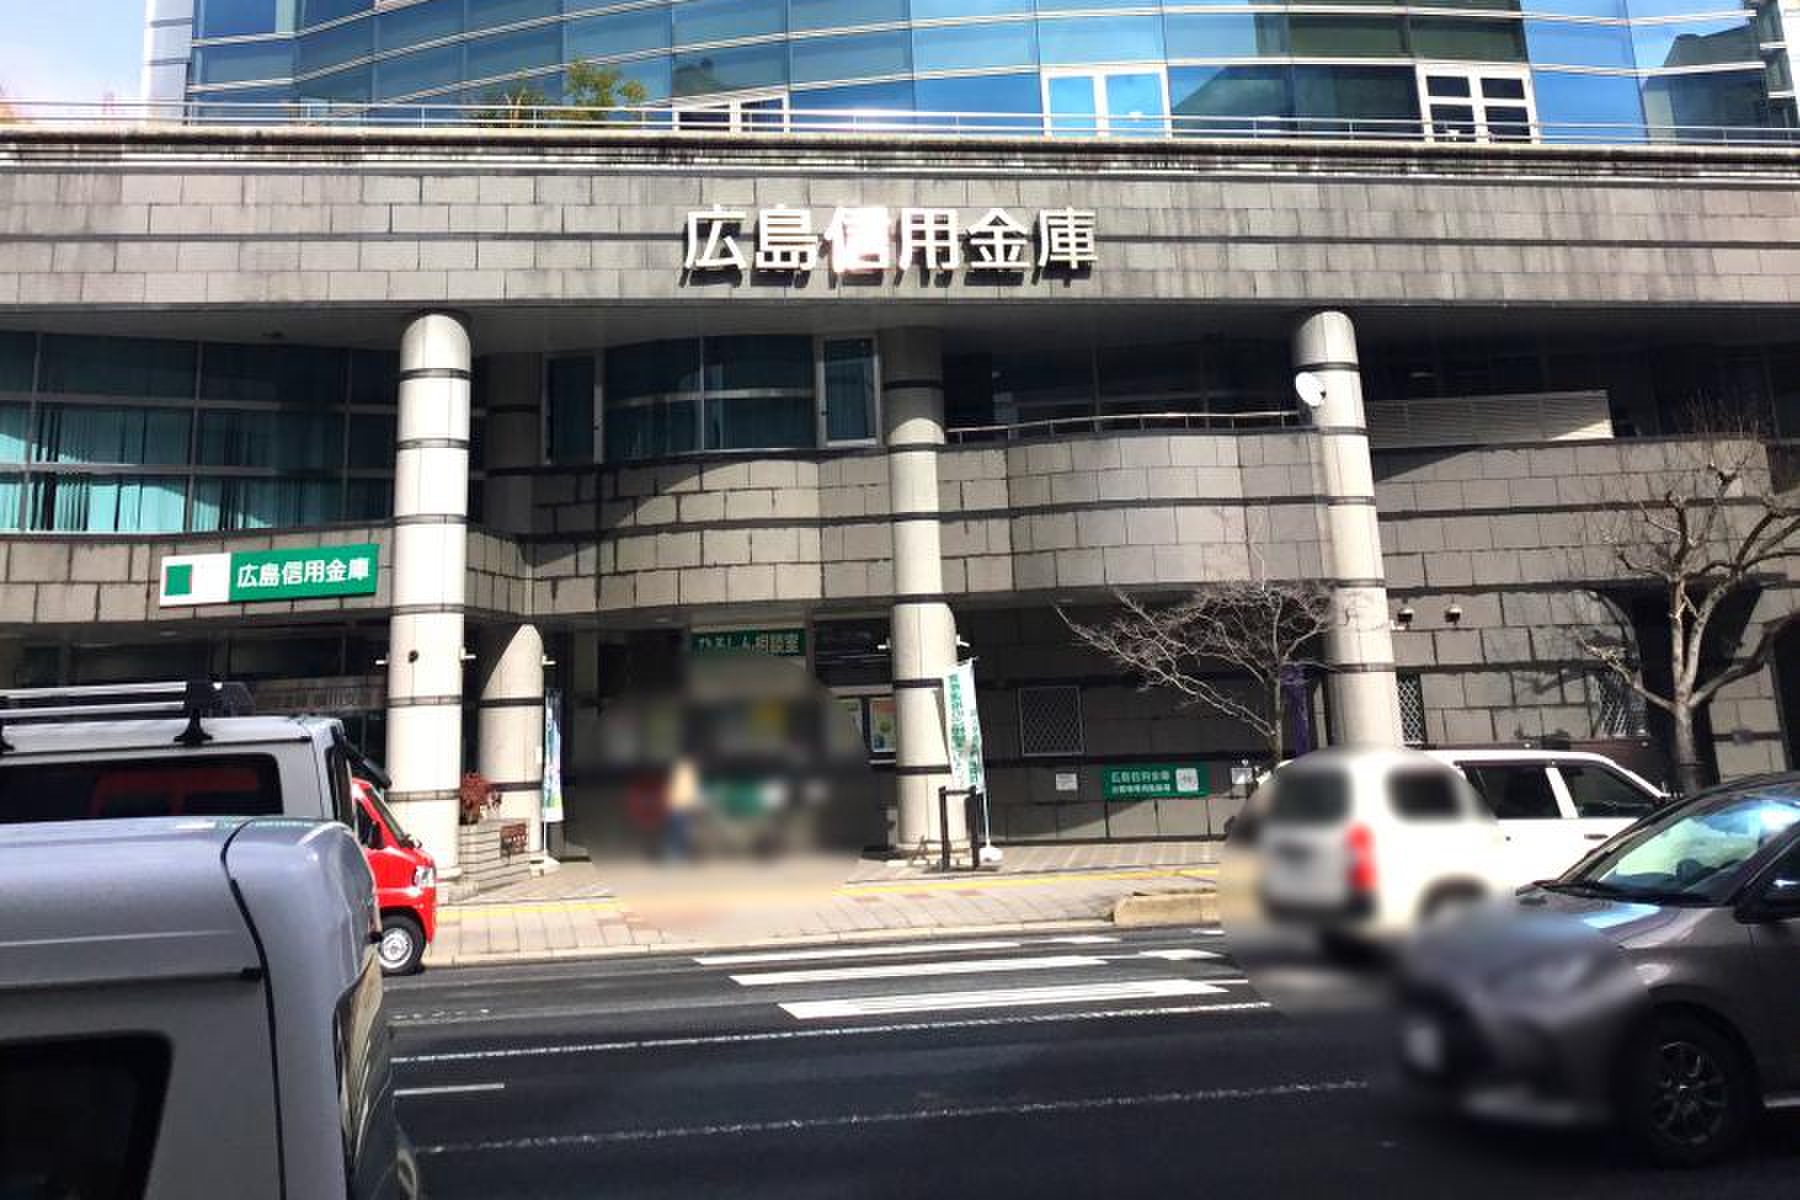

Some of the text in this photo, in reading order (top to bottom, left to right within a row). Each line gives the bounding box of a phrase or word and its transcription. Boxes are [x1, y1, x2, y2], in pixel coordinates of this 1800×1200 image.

[685, 204, 1098, 271] 広島信用金庫
[237, 557, 370, 589] 広島信用金庫
